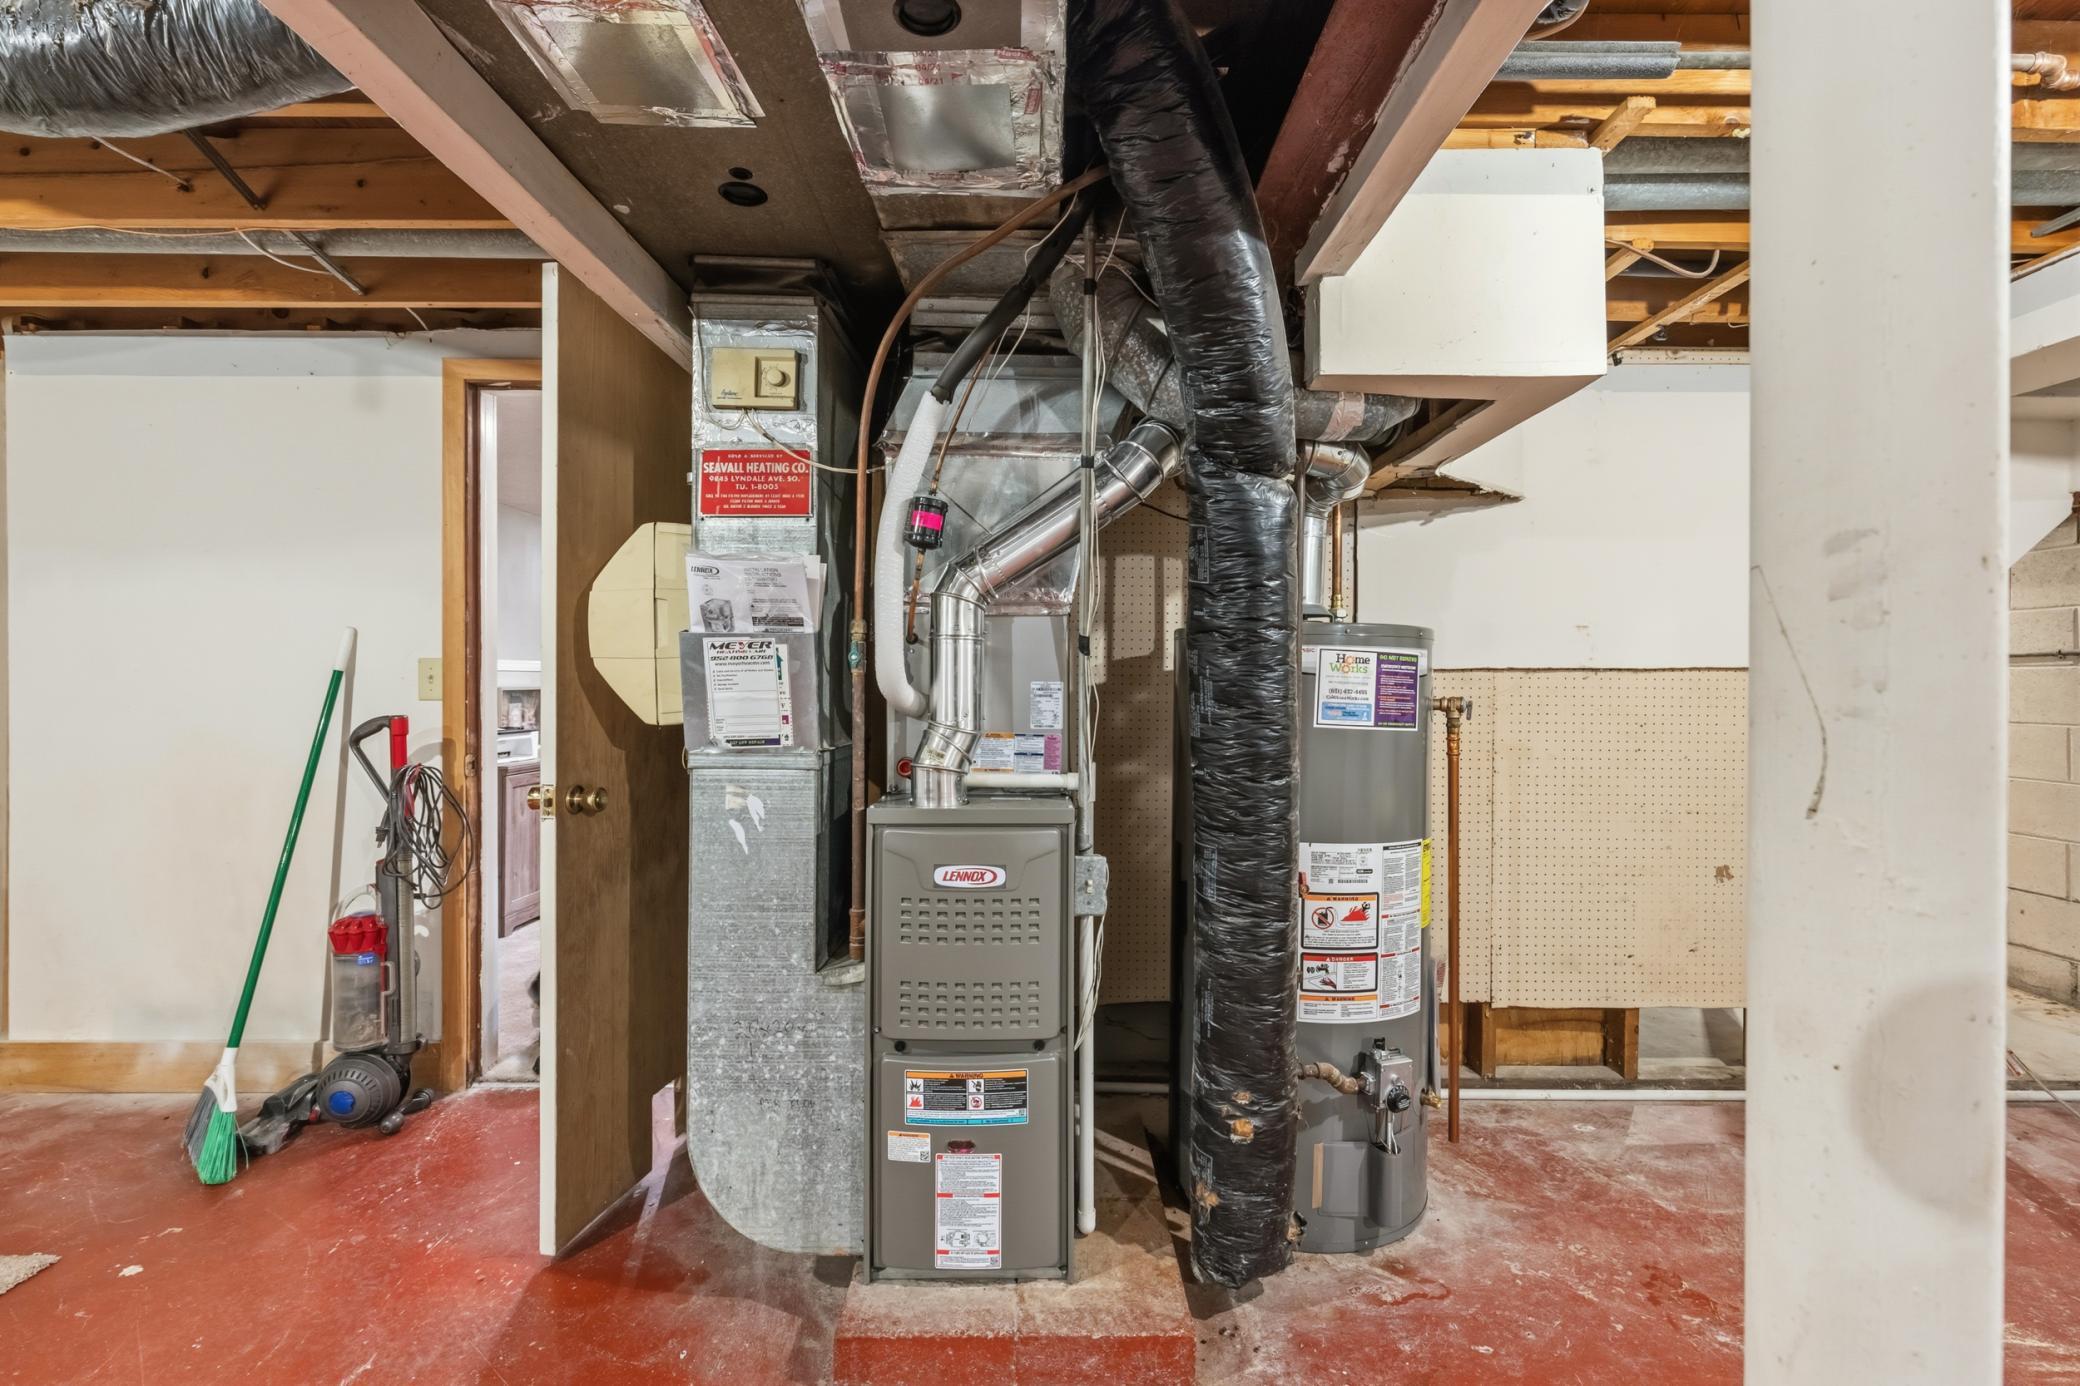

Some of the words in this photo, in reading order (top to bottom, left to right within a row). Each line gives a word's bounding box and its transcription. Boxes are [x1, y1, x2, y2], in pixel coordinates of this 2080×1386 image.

[703, 461, 745, 474] SEAVALL
[746, 461, 790, 474] HEATING
[791, 461, 809, 474] CO.
[709, 641, 772, 650] MEYER
[1335, 653, 1371, 665] Home
[1329, 662, 1369, 675] Works
[942, 870, 988, 882] LENNOX
